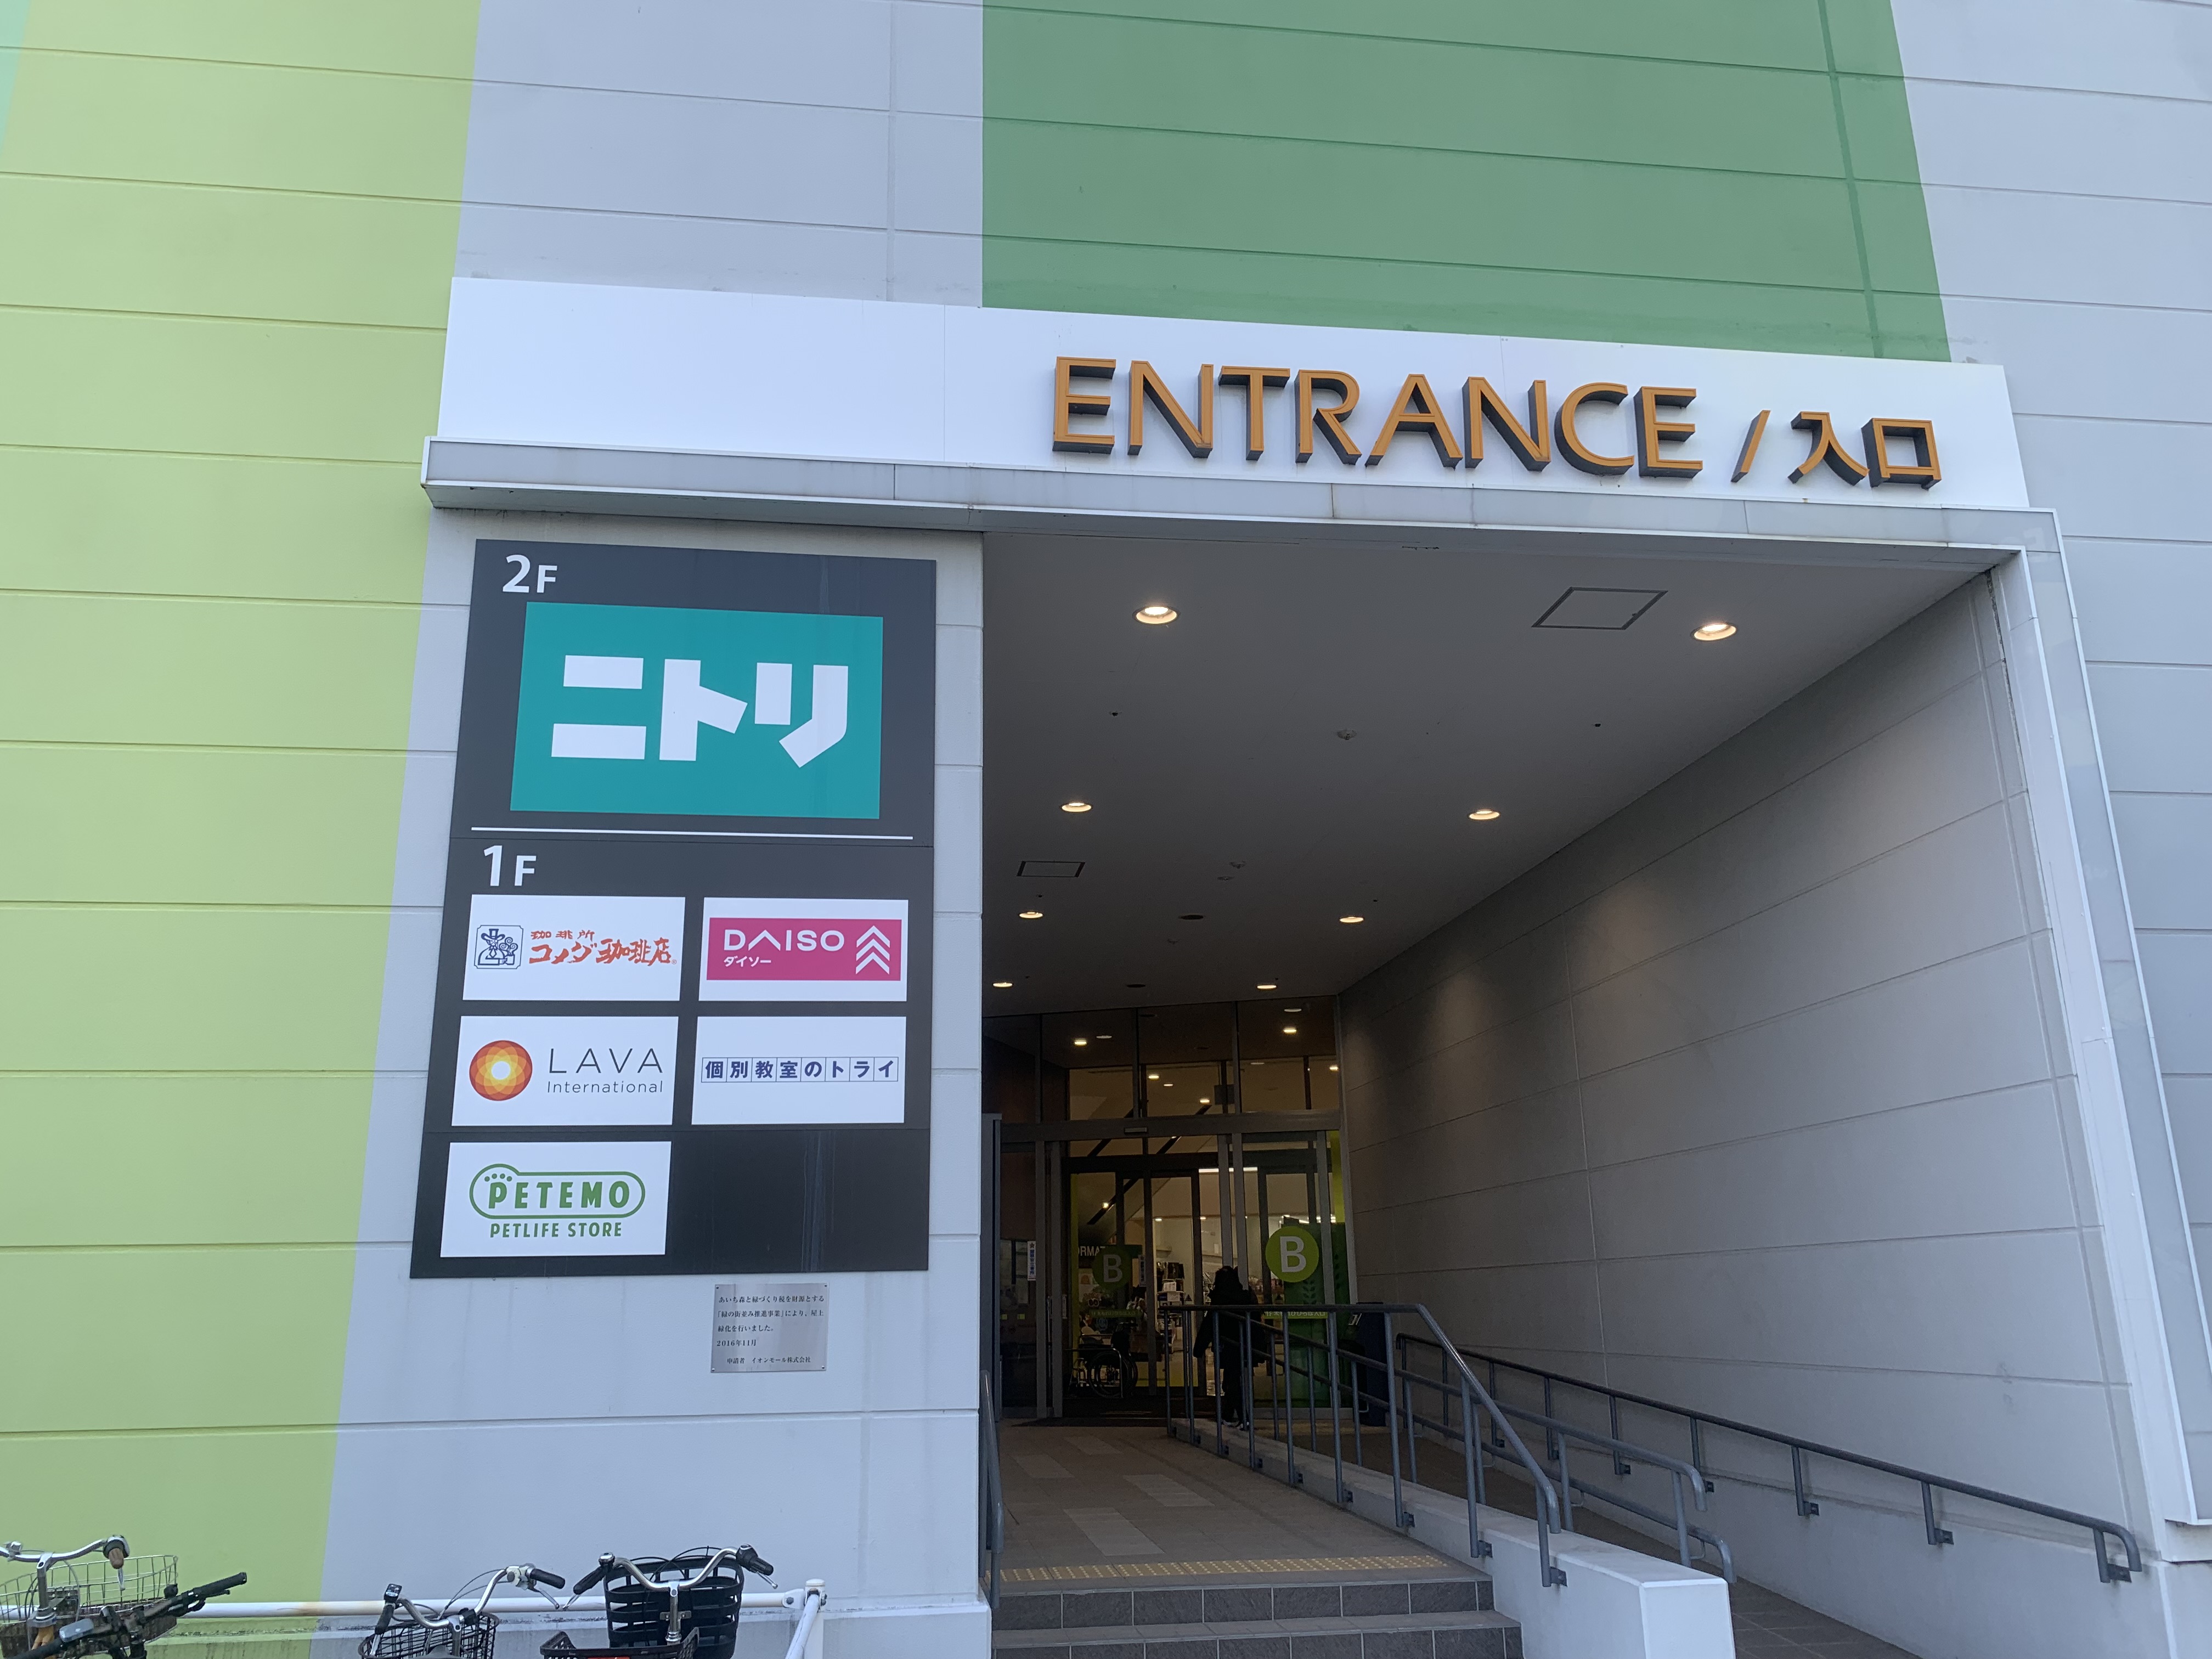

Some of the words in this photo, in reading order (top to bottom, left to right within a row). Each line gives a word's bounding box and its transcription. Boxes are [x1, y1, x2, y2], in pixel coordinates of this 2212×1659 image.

[1053, 356, 1703, 478] ENTRANCE
[1788, 411, 1942, 489] 入口
[502, 554, 558, 594] 2F
[551, 654, 849, 768] ニトリ
[483, 845, 537, 887] 1F
[530, 929, 595, 941] 珈琲所
[723, 929, 845, 952] DAISO
[529, 937, 672, 966] コメダ珈琲店
[723, 956, 772, 968] ダイソー
[549, 1048, 663, 1074] LAVA
[704, 1060, 896, 1080] 個別教室のトライ
[547, 1080, 663, 1094] International
[488, 1181, 630, 1209] PETEMO
[490, 1223, 560, 1238] PETLIFE
[568, 1222, 623, 1238] STORE
[1279, 1235, 1307, 1273] B
[1103, 1254, 1123, 1283] B
[718, 1295, 825, 1303] あいち森と緑づくり税を財源とする
